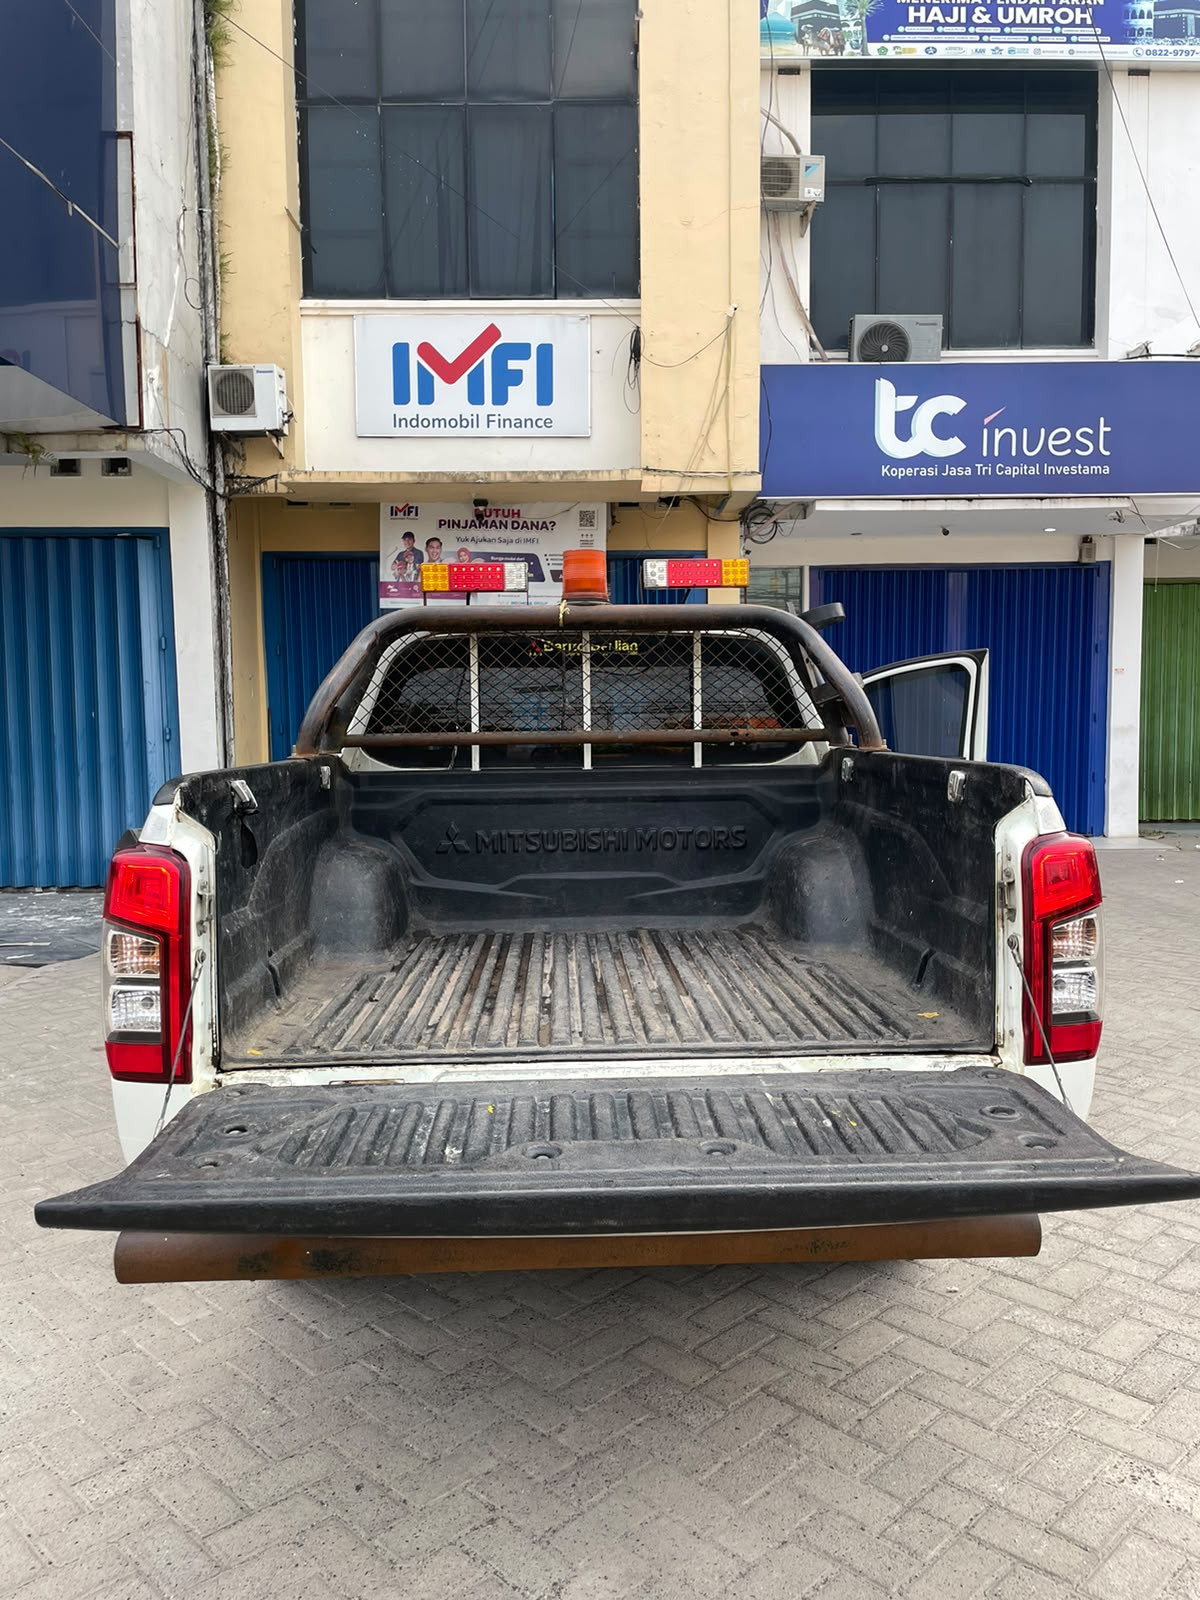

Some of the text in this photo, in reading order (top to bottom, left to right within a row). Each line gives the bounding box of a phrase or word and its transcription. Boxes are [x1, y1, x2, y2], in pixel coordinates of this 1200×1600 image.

[908, 6, 1092, 24] HAJI & UMROH
[1145, 49, 1200, 57] 0822-9797-
[392, 323, 553, 406] IMFI
[393, 413, 553, 429] Indomobil Finance
[875, 377, 1112, 459] tc invest
[881, 463, 1110, 480] Koperasi Jasa Tri Capital Investama
[390, 503, 418, 517] IMFI
[438, 519, 556, 531] PINJAMAN DANA?
[470, 536, 497, 545] Ajukan
[498, 537, 514, 545] Saja
[475, 825, 748, 854] MITSUBISHI MOTORS
